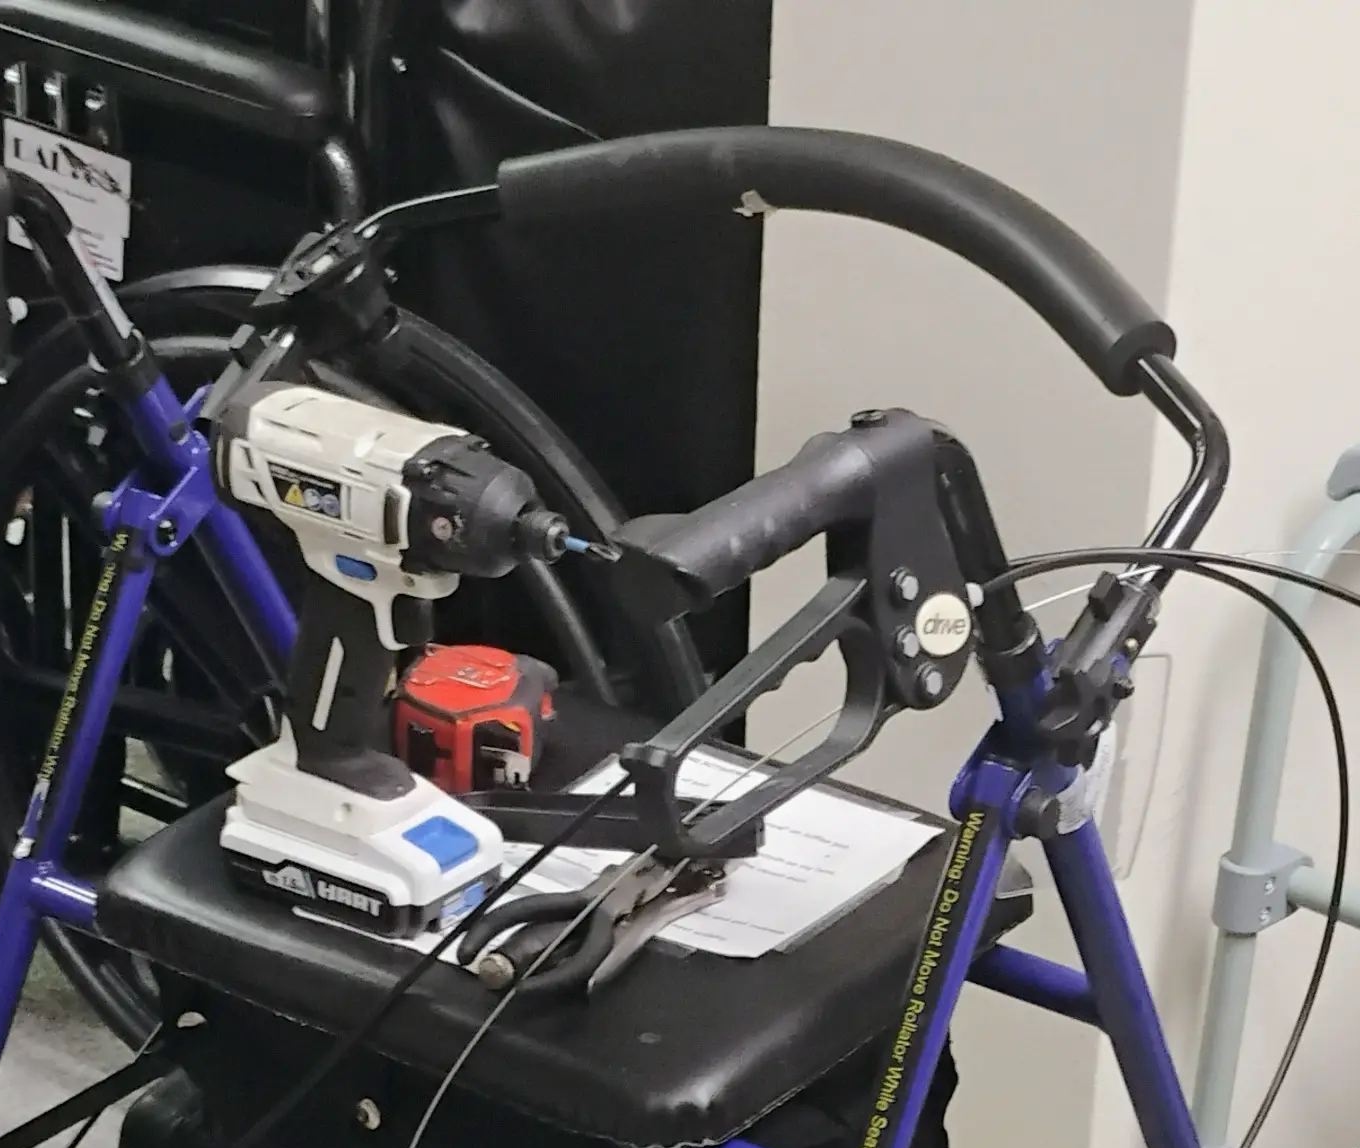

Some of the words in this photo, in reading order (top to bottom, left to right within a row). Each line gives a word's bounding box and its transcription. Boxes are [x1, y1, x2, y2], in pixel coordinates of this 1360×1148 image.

[923, 612, 966, 635] drive
[947, 811, 984, 884] Warning:
[317, 879, 384, 917] HART
[938, 887, 960, 914] Do
[927, 915, 951, 948] Not
[912, 949, 941, 996] Move
[892, 998, 926, 1063] Rollator
[875, 1066, 905, 1112] While
